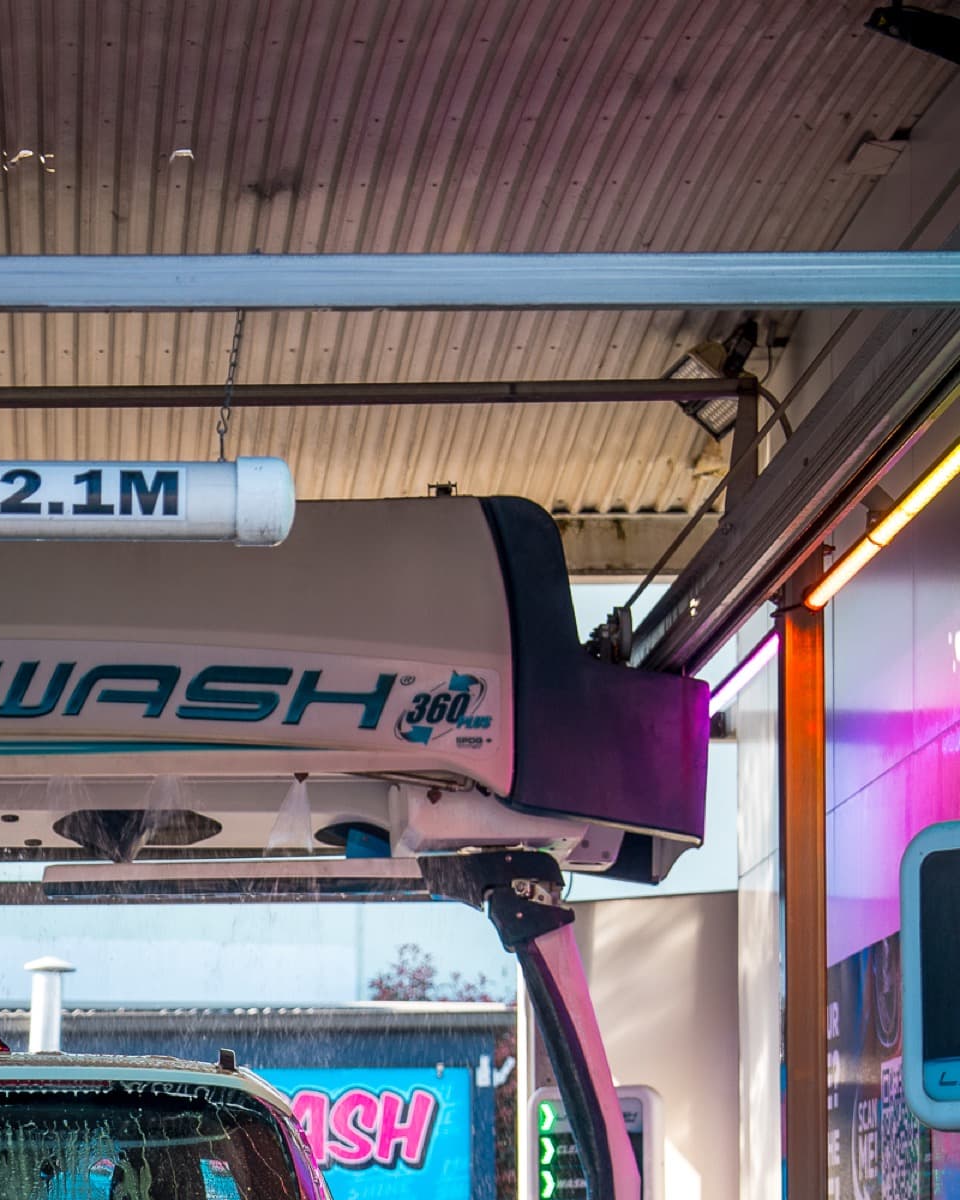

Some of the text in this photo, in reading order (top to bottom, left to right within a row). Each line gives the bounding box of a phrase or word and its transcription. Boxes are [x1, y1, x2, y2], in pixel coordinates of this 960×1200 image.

[0, 468, 180, 516] 2.1M
[405, 692, 471, 724] 360
[456, 715, 493, 729] PLUS
[288, 1089, 438, 1168] ASH
[858, 1098, 877, 1131] SCAN
[858, 1131, 878, 1180] ME!
